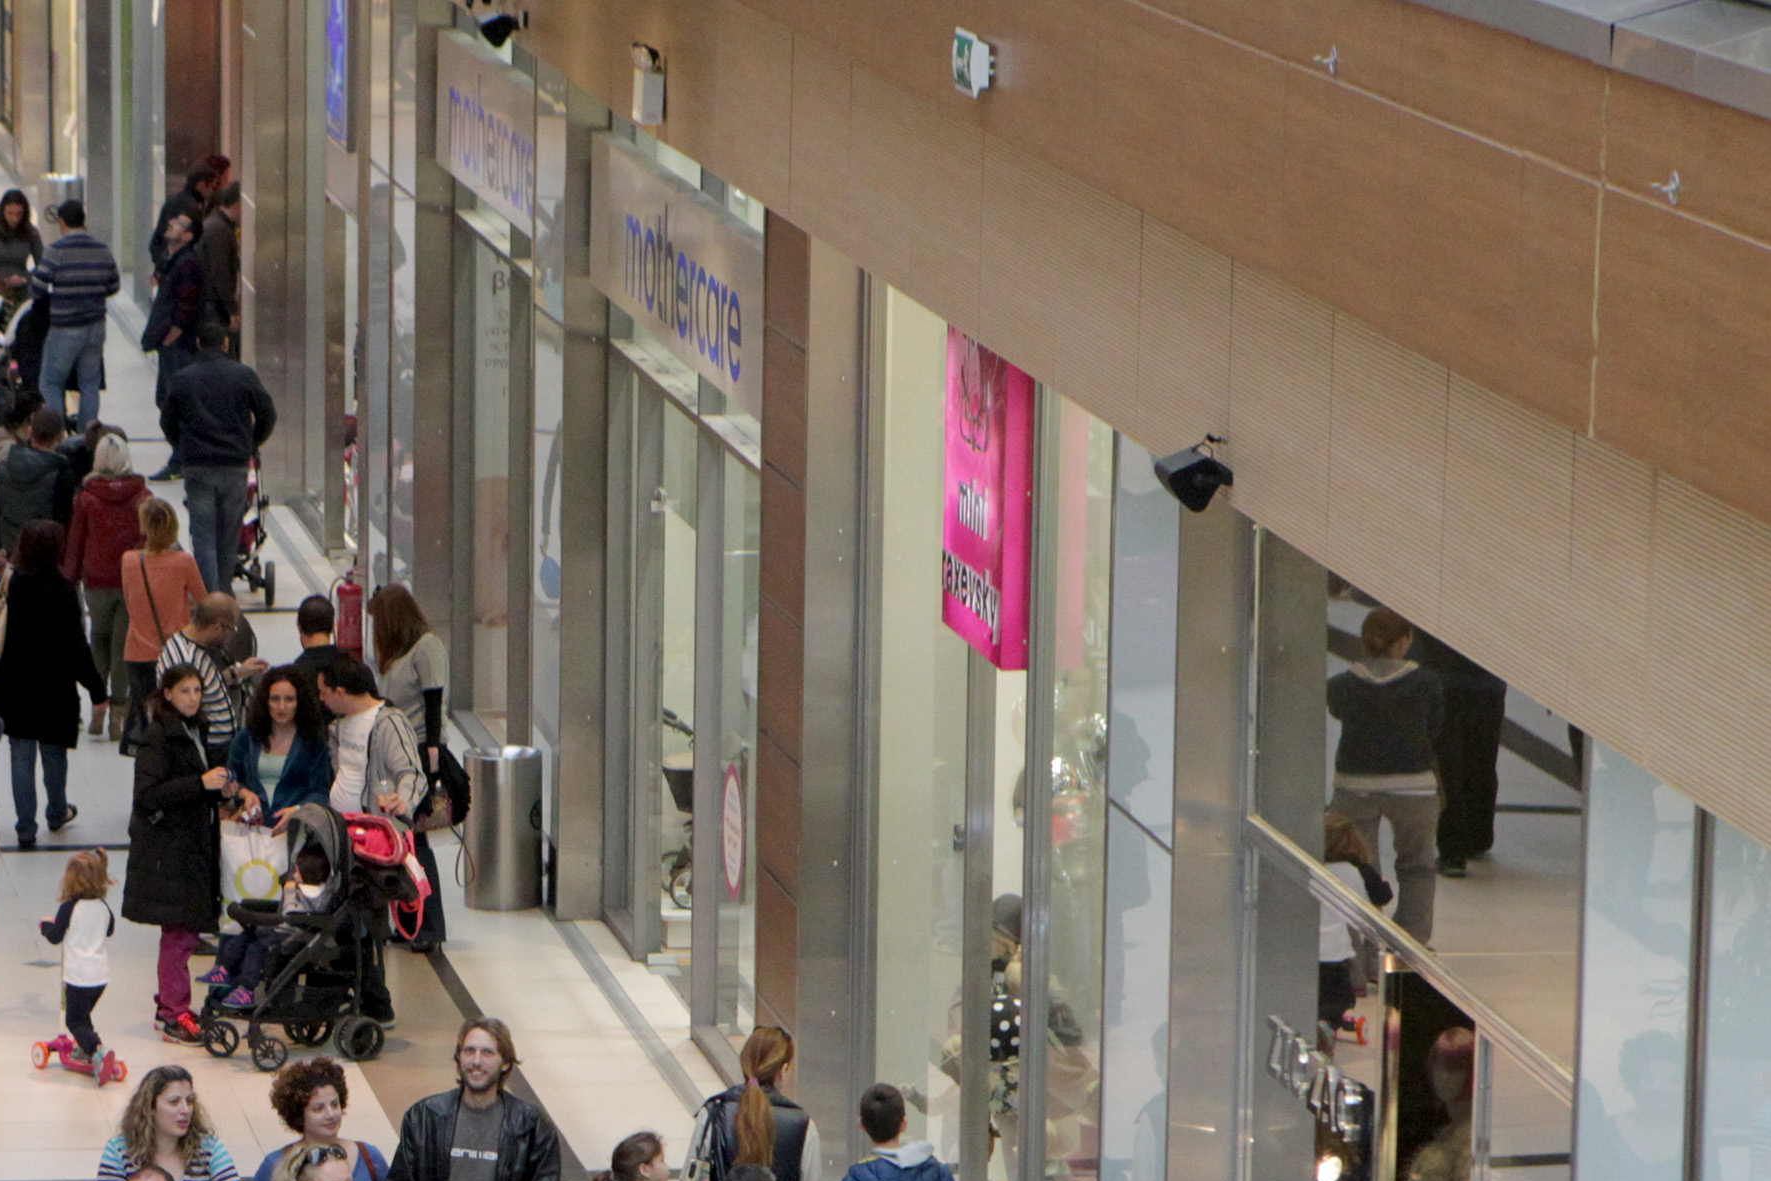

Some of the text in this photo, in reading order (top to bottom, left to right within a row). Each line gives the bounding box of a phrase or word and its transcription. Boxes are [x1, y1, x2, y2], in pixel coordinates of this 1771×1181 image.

[450, 74, 534, 222] mothercare
[625, 202, 742, 383] mothercare
[958, 478, 989, 540] mini
[942, 549, 1001, 646] raxevsky
